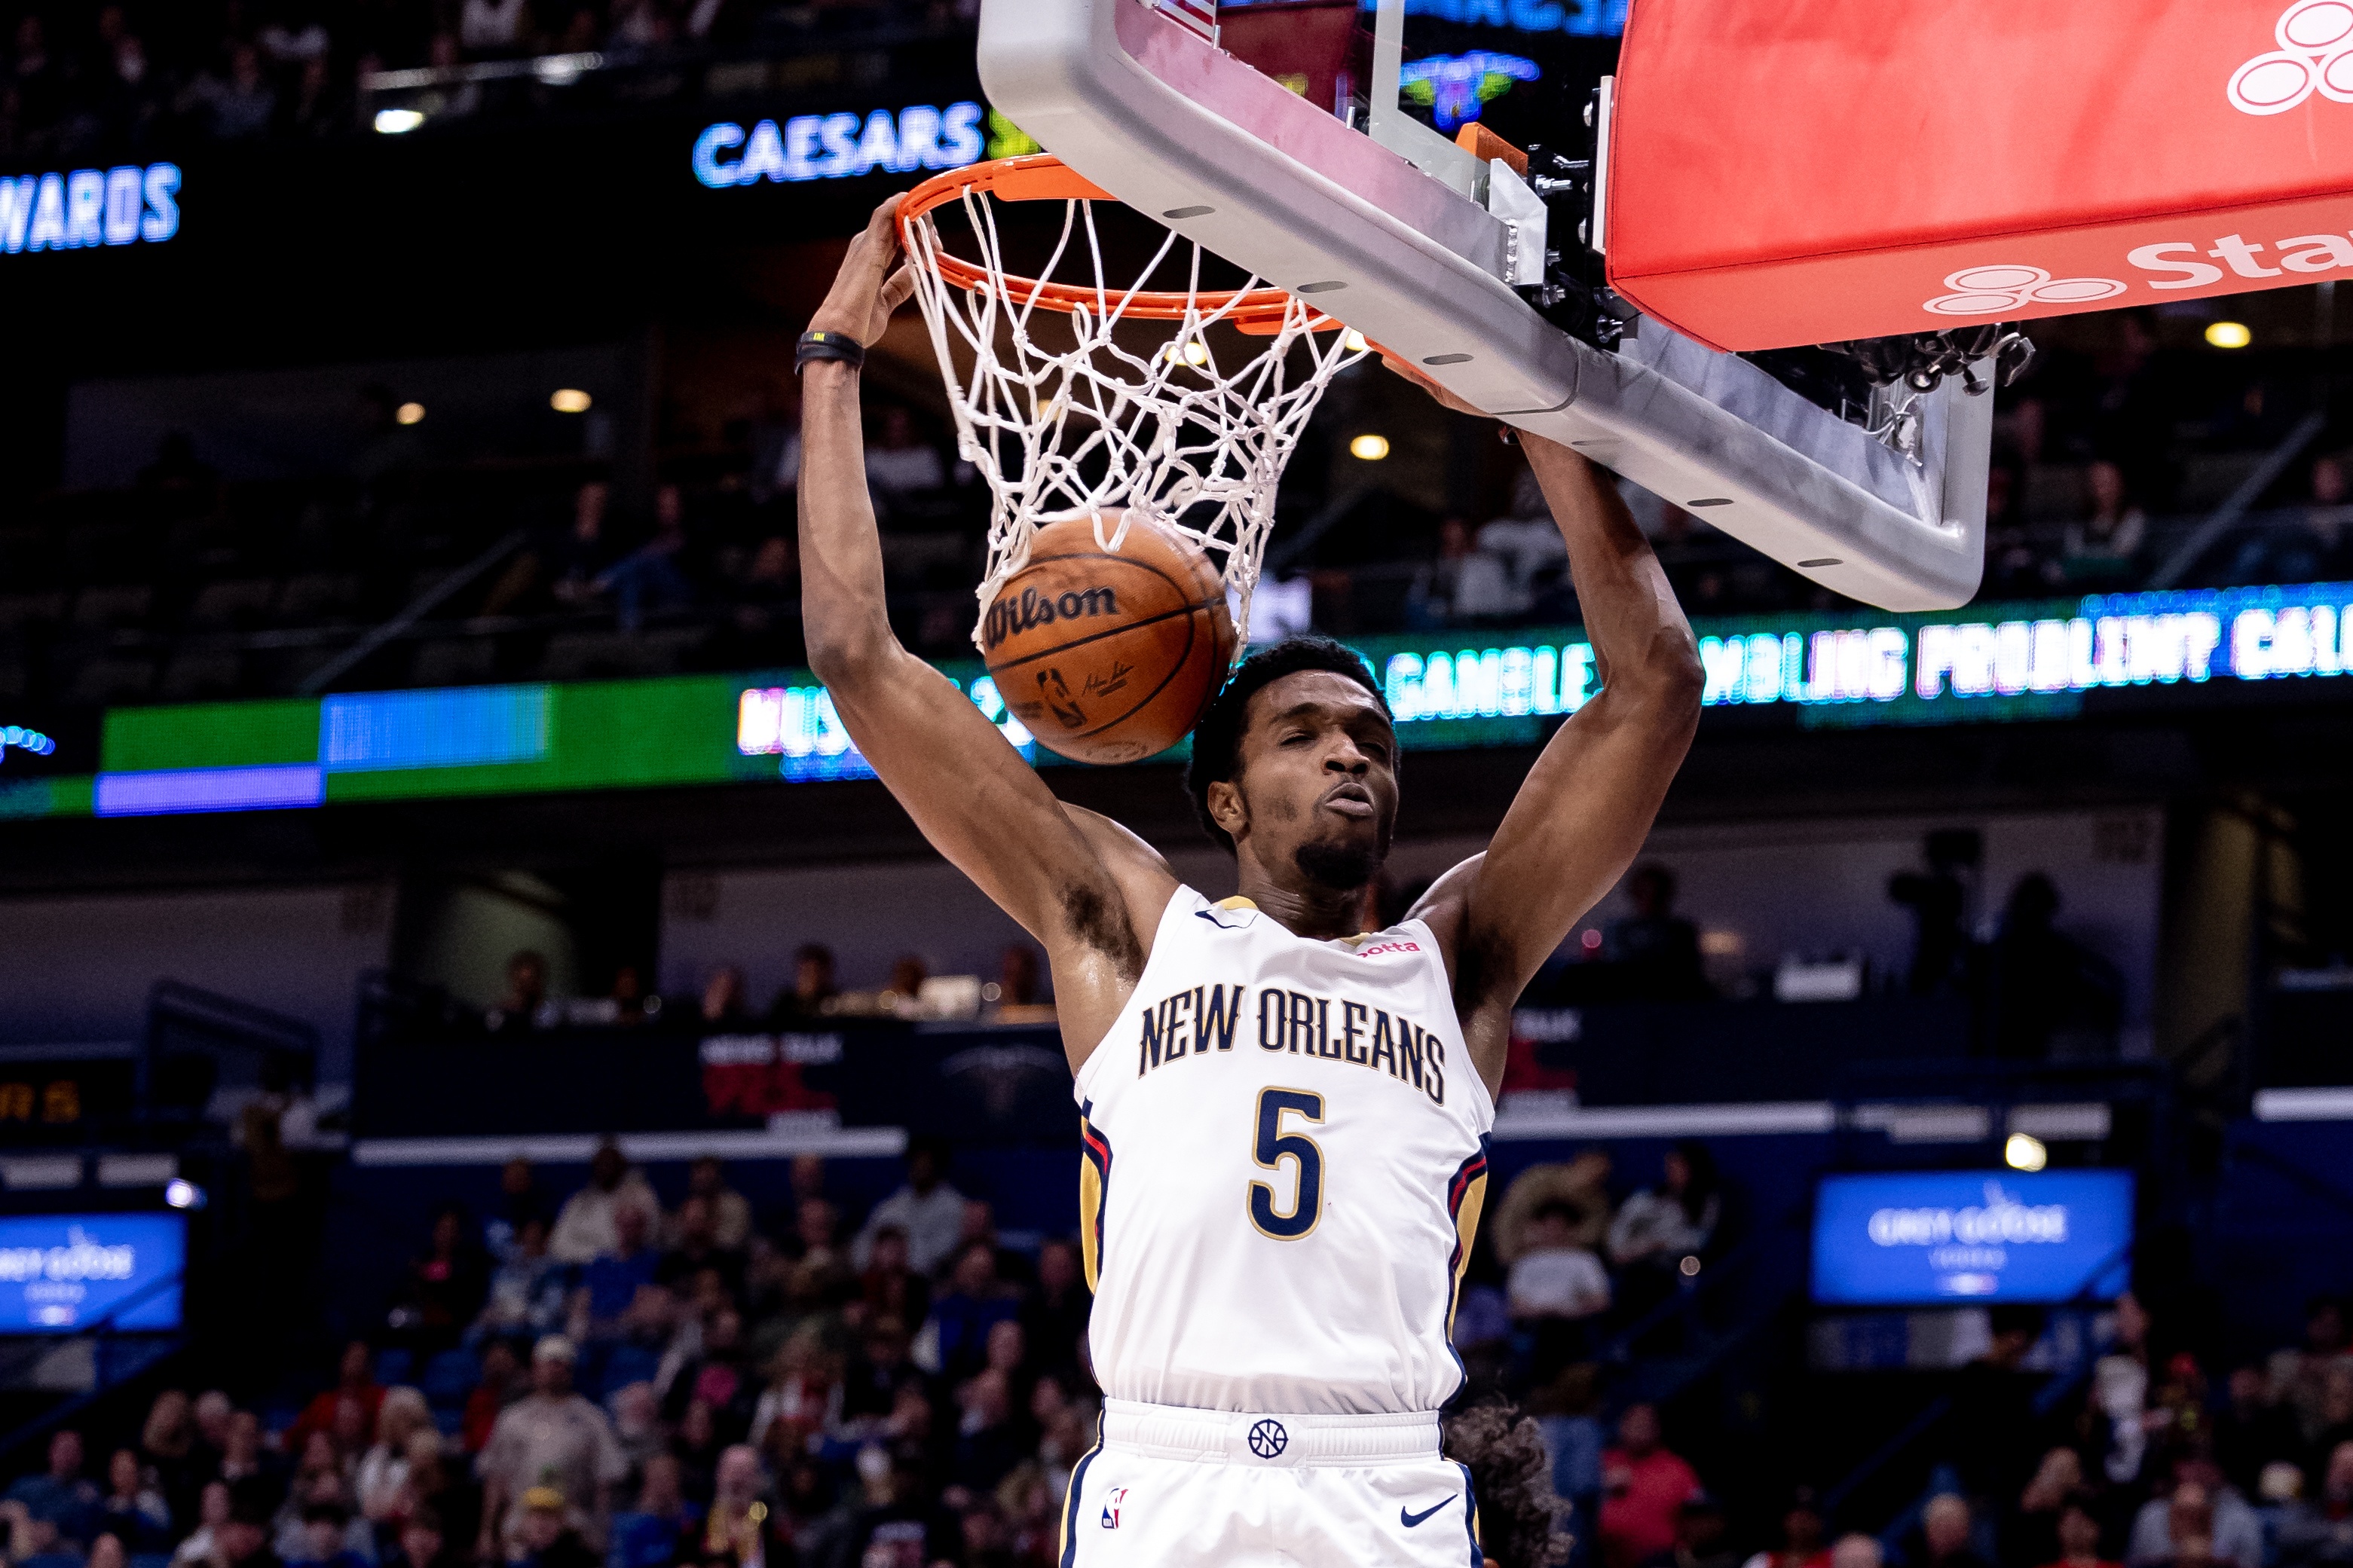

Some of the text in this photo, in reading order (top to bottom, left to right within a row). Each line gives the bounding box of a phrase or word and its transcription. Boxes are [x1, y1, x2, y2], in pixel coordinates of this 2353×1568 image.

[693, 102, 984, 188] CAESARS
[2127, 233, 2353, 289] Sta
[982, 585, 1120, 651] Wilson
[1698, 627, 1908, 705] MBLING
[1137, 983, 1246, 1080] NEW
[1256, 987, 1446, 1107] ORLEANS
[1246, 1086, 1325, 1242] 5
